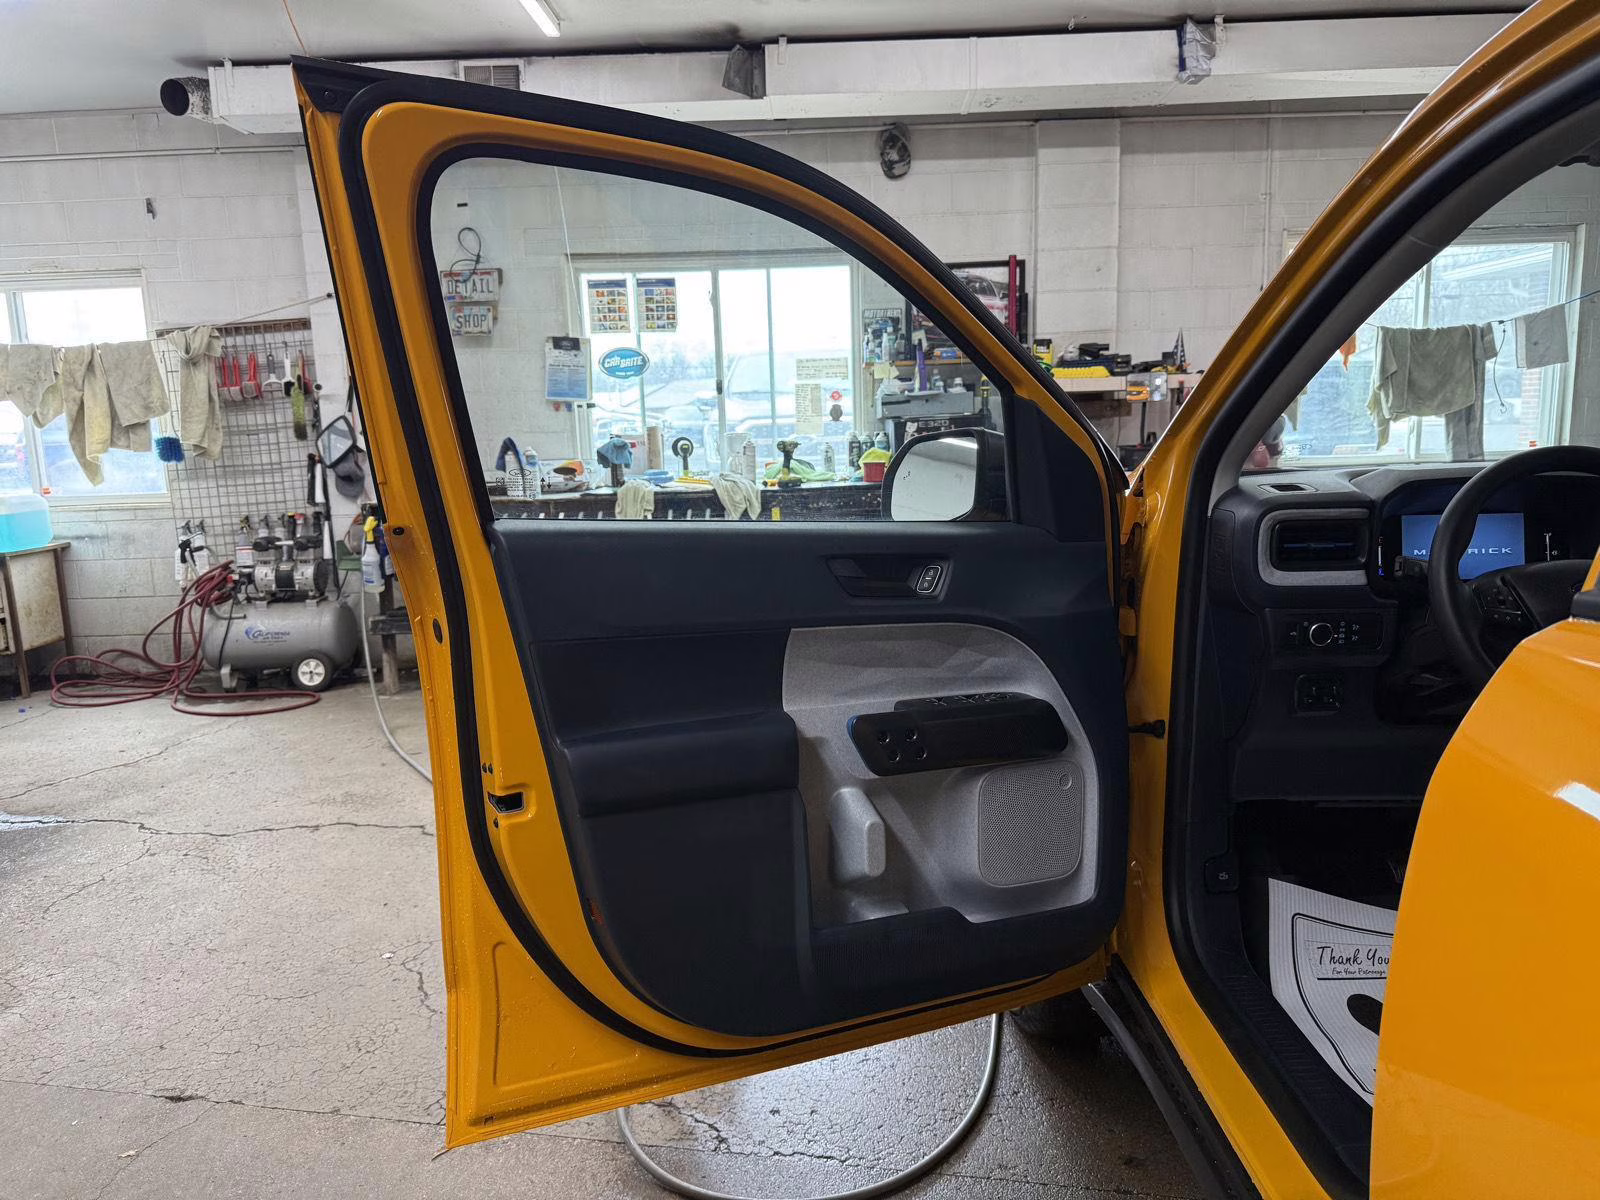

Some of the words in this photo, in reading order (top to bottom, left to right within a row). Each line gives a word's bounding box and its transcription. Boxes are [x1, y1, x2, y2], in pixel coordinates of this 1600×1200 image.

[447, 279, 494, 295] DETAIL
[456, 313, 487, 329] SHOP
[1413, 547, 1512, 555] MRICK
[1316, 945, 1362, 966] Thank
[1366, 948, 1390, 967] You
